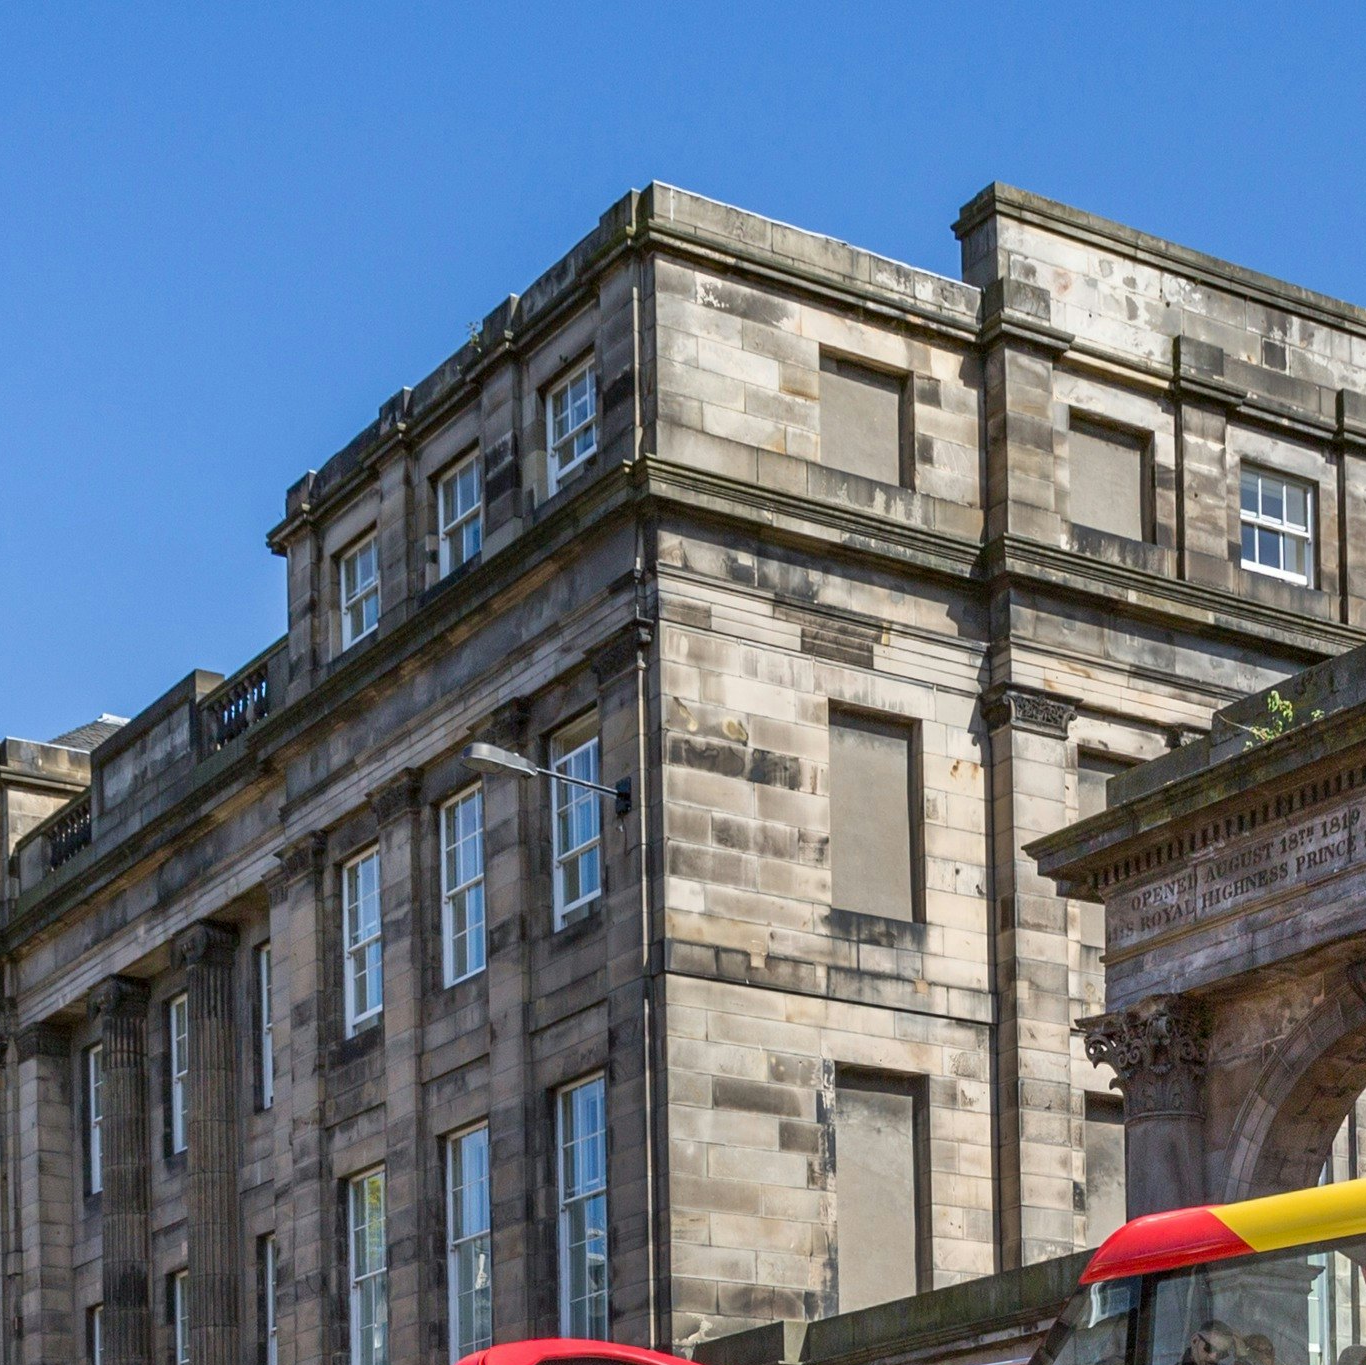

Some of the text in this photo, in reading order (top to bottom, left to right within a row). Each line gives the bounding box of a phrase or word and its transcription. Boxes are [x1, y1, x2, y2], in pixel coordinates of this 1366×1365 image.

[1131, 875, 1197, 912] OPENED
[1204, 842, 1274, 884] AUGUST
[1320, 809, 1360, 839] 1819
[1140, 902, 1197, 932] ROYAL
[1201, 862, 1288, 910] HIGHNESS
[1295, 836, 1357, 875] PRINCE
